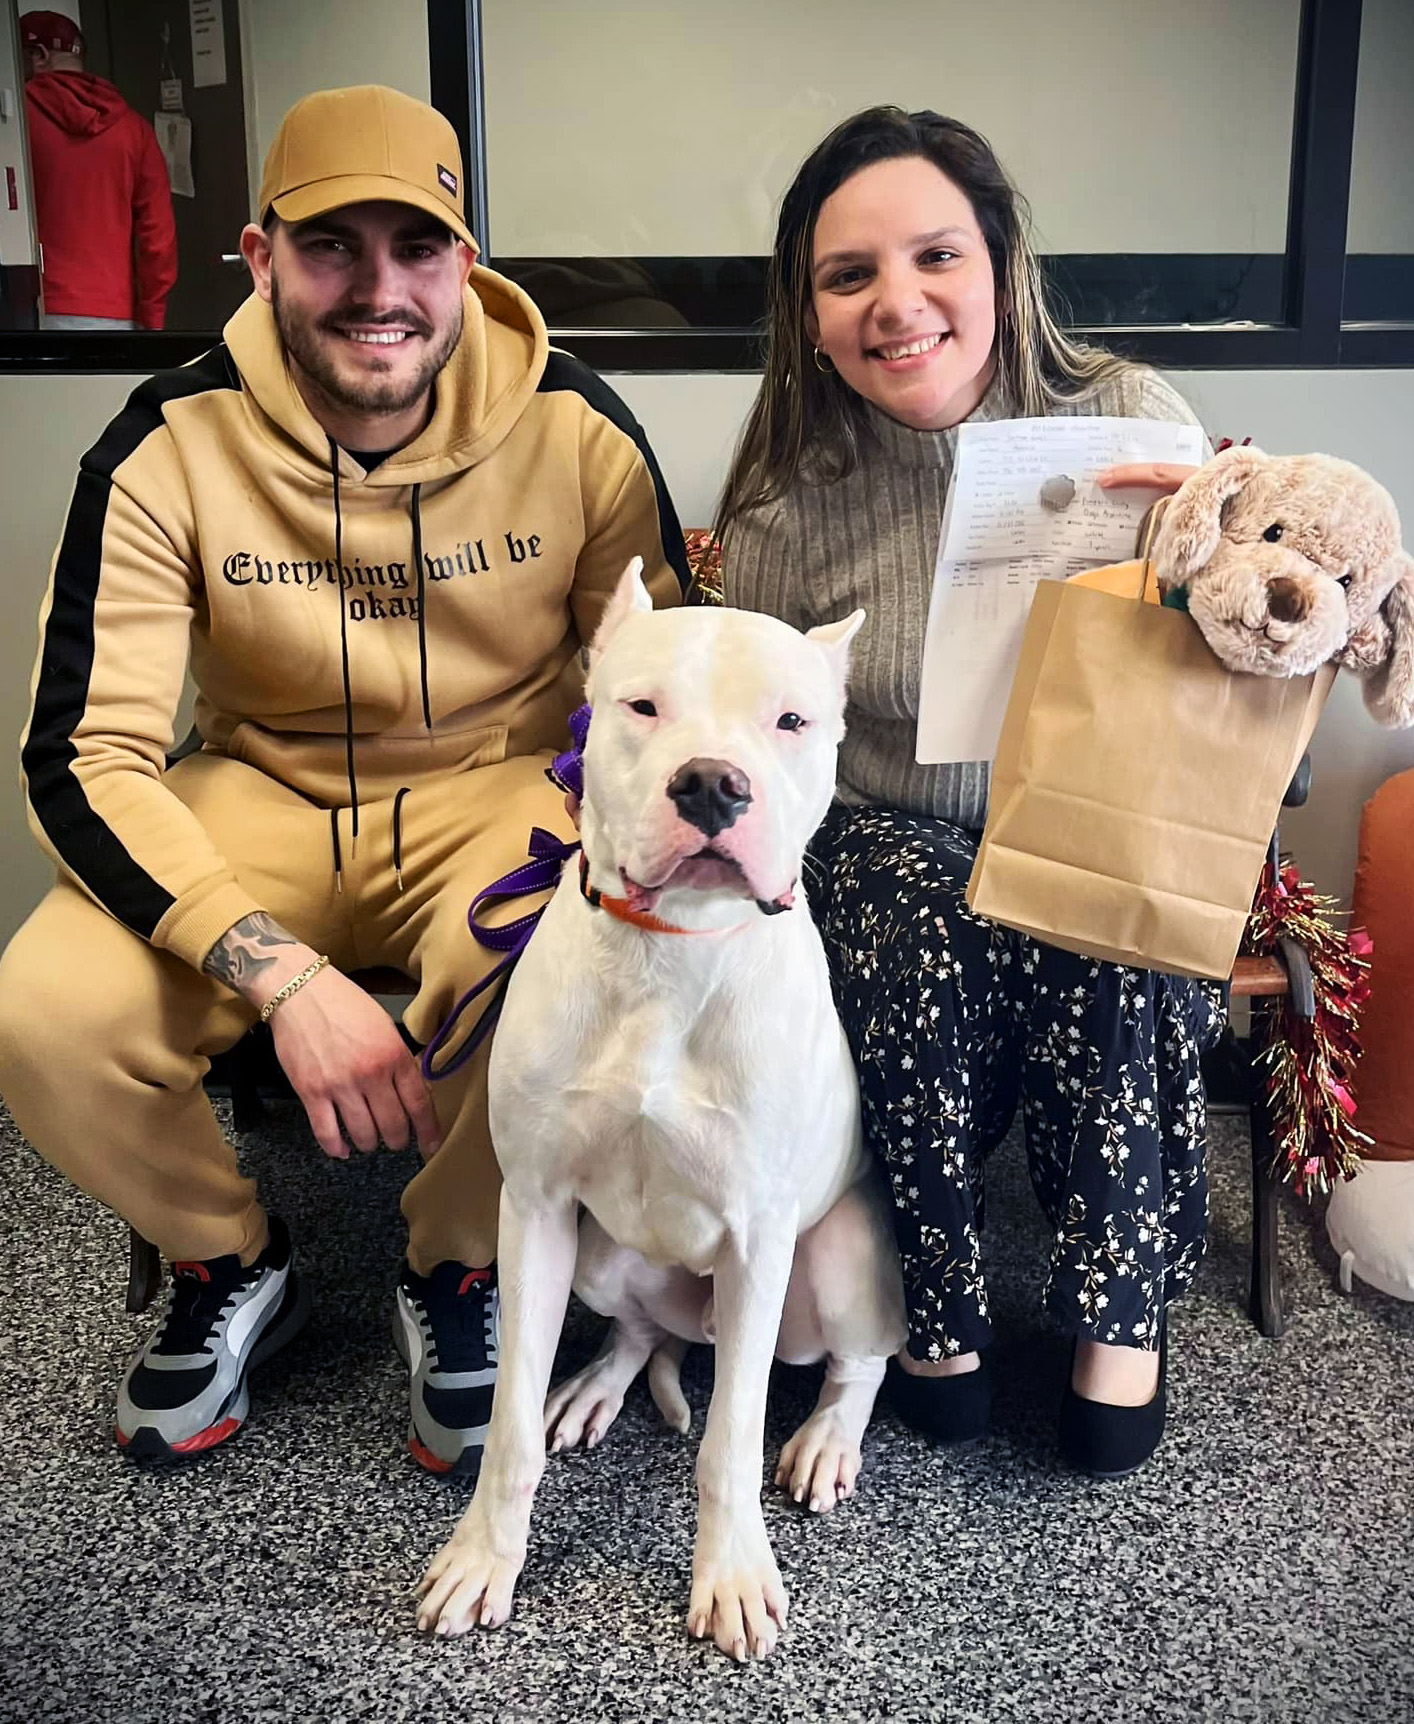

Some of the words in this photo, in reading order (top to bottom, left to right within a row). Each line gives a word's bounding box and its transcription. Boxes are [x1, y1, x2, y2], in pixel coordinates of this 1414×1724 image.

[223, 552, 409, 591] Everything
[424, 540, 490, 581] will
[504, 531, 542, 563] be
[349, 592, 422, 622] okay
